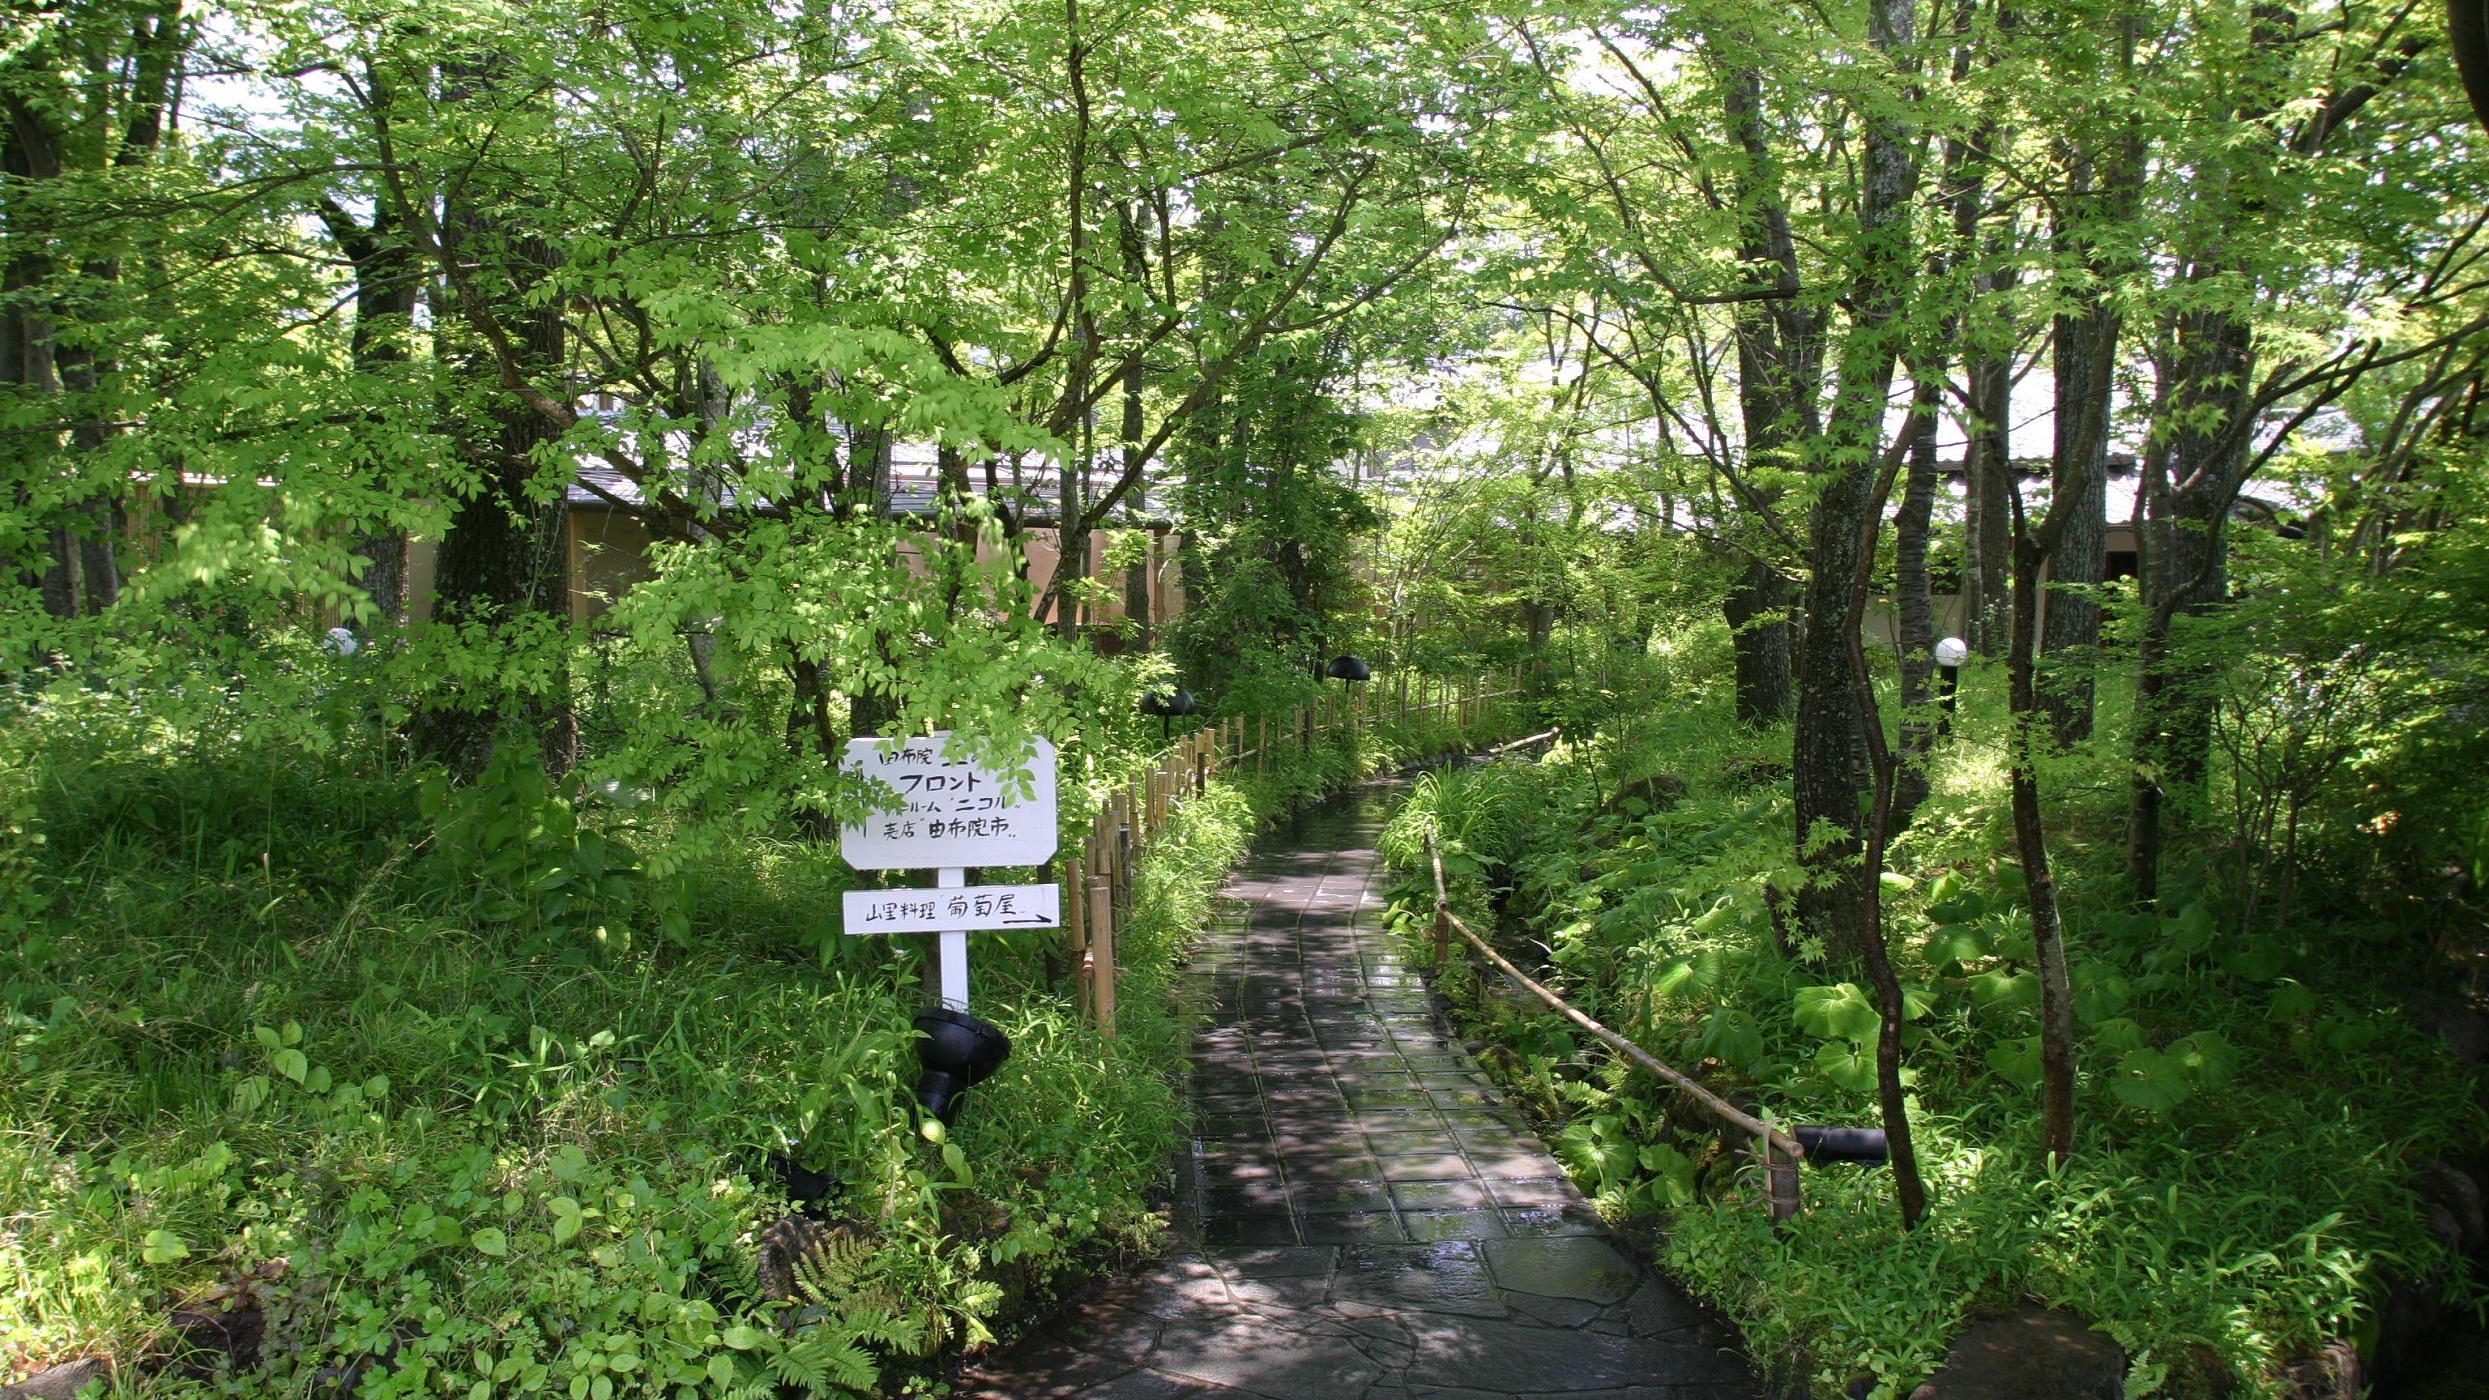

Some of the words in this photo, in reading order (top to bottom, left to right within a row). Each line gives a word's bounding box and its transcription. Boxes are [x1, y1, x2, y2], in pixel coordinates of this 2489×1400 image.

[899, 771, 983, 794] フロント
[883, 821, 917, 840] 売店
